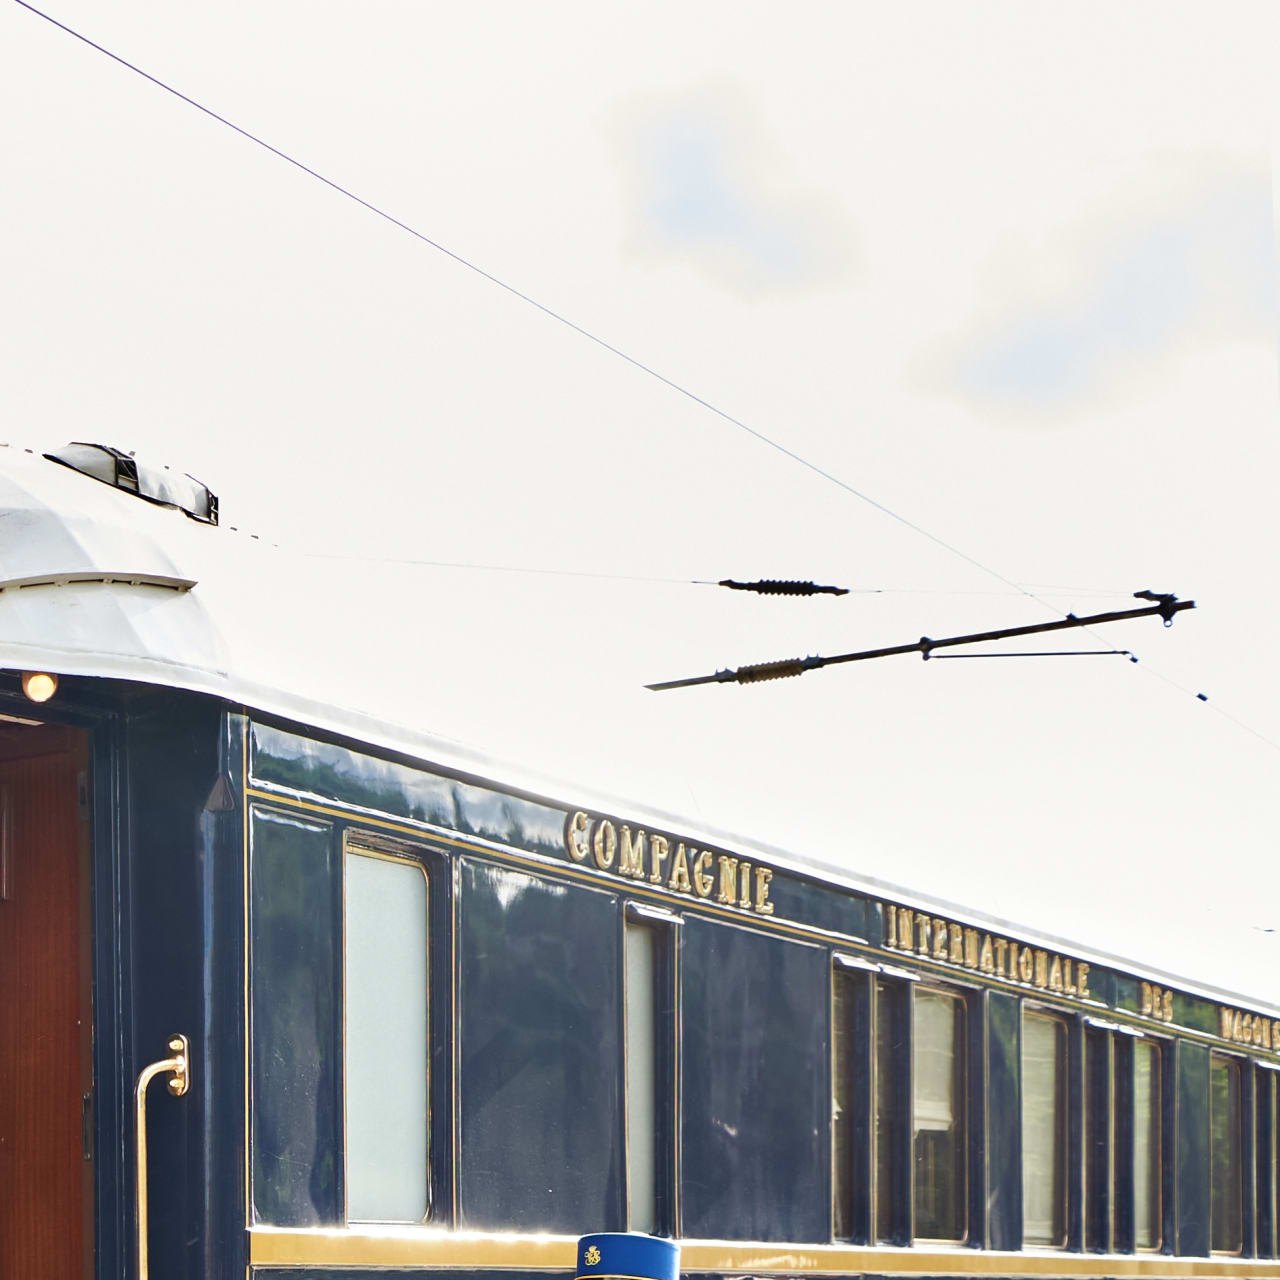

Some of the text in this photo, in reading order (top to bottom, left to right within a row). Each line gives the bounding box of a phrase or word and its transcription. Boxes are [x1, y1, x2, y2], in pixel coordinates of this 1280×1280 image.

[567, 810, 774, 915] COMPAGNIE
[886, 905, 1091, 999] INTERNATIONALE
[1141, 981, 1174, 1022] DES
